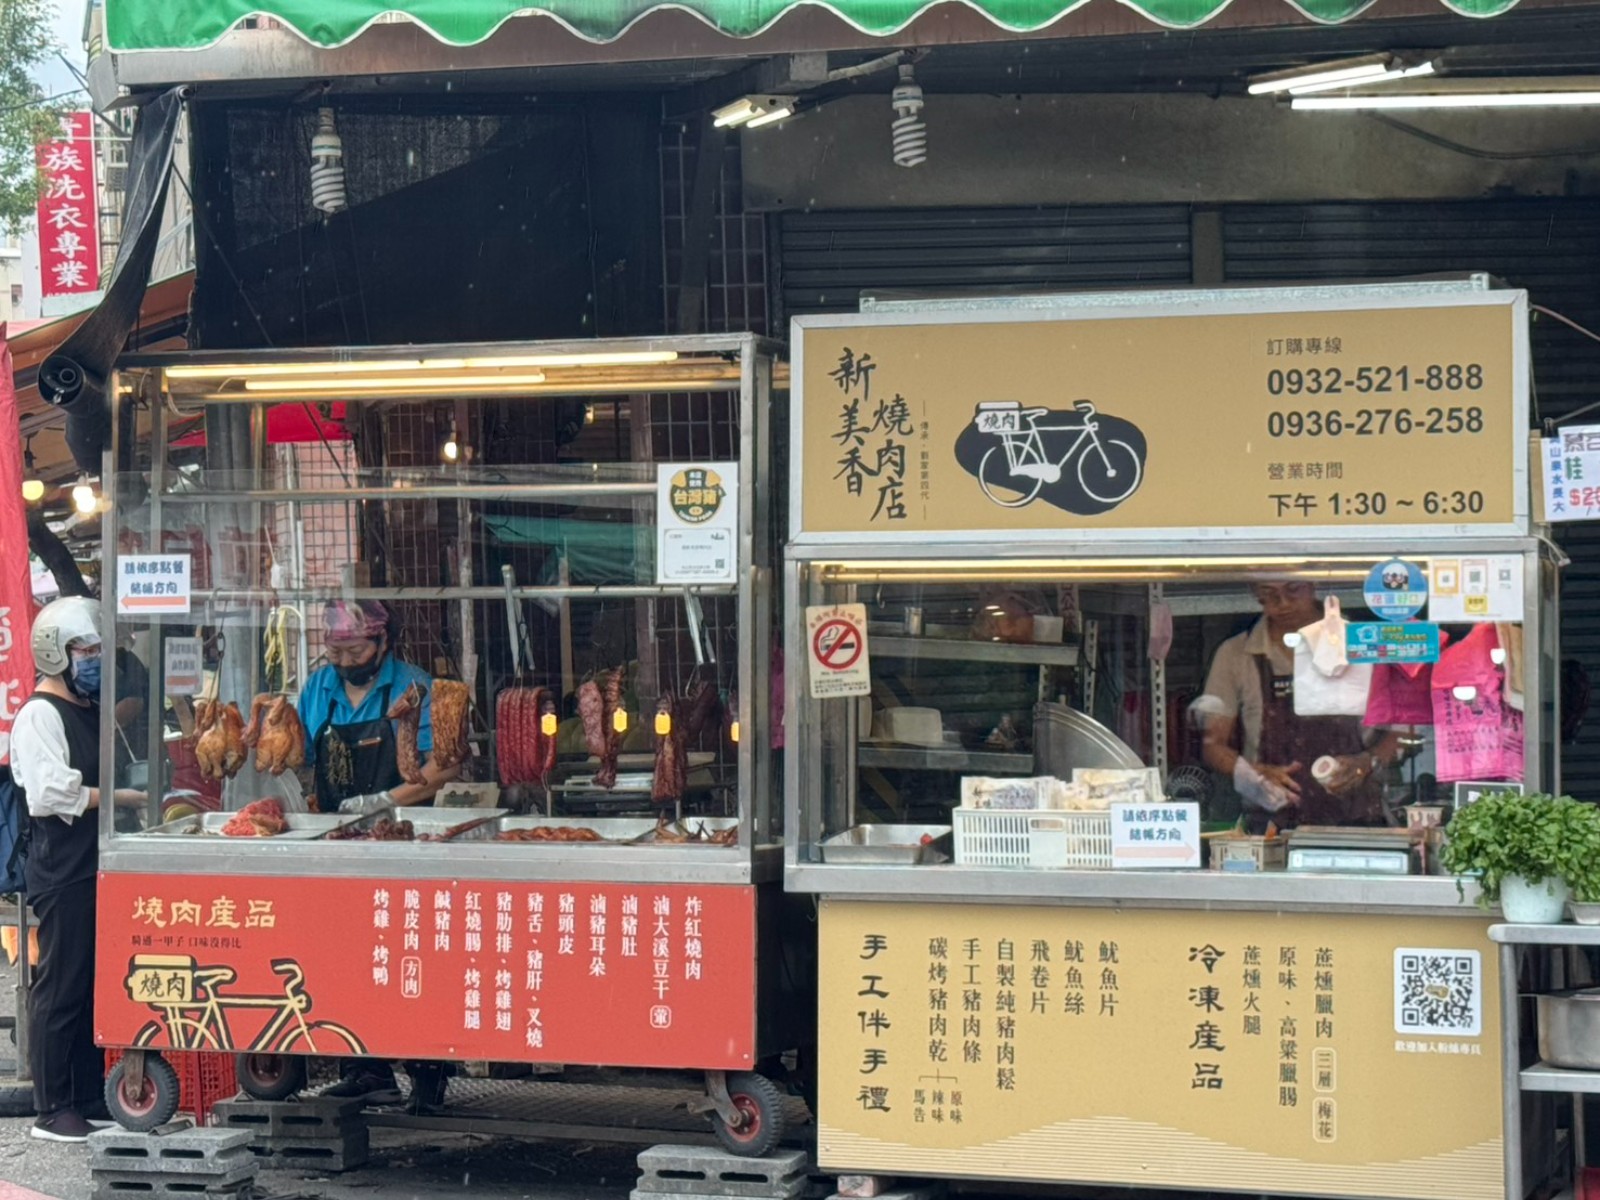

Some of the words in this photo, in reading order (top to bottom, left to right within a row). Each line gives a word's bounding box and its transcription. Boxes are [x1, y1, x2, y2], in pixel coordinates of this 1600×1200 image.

[1267, 337, 1342, 356] 訂購專線
[1267, 363, 1484, 395] 0932-521-888
[827, 346, 880, 497] 新美香
[983, 410, 1016, 430] 燒肉
[1267, 406, 1484, 438] 0936-276-258
[870, 393, 914, 522] 燒肉店
[1267, 462, 1343, 480] 營業時間
[1268, 493, 1317, 517] 下午
[1328, 492, 1387, 515] 1:30
[1423, 490, 1484, 514] 6:30
[125, 561, 183, 574] 請依序點餐
[131, 582, 177, 595] 結帳方向
[1123, 809, 1187, 822] 請依序點餐
[1129, 827, 1181, 841] 結帳方向
[404, 889, 421, 951] 脆皮肉
[434, 890, 451, 951] 鹹豬肉
[558, 893, 575, 955] 豬頭皮
[589, 893, 606, 977] 滷豬耳朵
[621, 895, 638, 957] 滷豬肚
[653, 895, 670, 1000] 滷大溪豆干
[685, 896, 702, 980] 炸紅燒肉
[140, 971, 186, 999] 燒肉
[405, 961, 419, 995] 方肉
[928, 937, 948, 1063] 碳烤豬肉乾
[962, 938, 982, 1064] 手工豬肉條
[1029, 940, 1050, 1014] 飛卷片
[1064, 940, 1084, 1015] 魷魚絲
[1099, 941, 1119, 1017] 魷魚片
[1242, 945, 1262, 1036] 蔗燻火腿
[1314, 947, 1334, 1039] 蔗燻臘肉
[857, 934, 891, 1113] 手工伴手禮
[996, 938, 1015, 1091] 自製純豬肉鬆
[1317, 1053, 1332, 1088] 三層
[913, 1089, 926, 1123] 馬告
[931, 1089, 944, 1123] 辣味
[950, 1090, 963, 1124] 原味
[1317, 1102, 1333, 1138] 梅花
